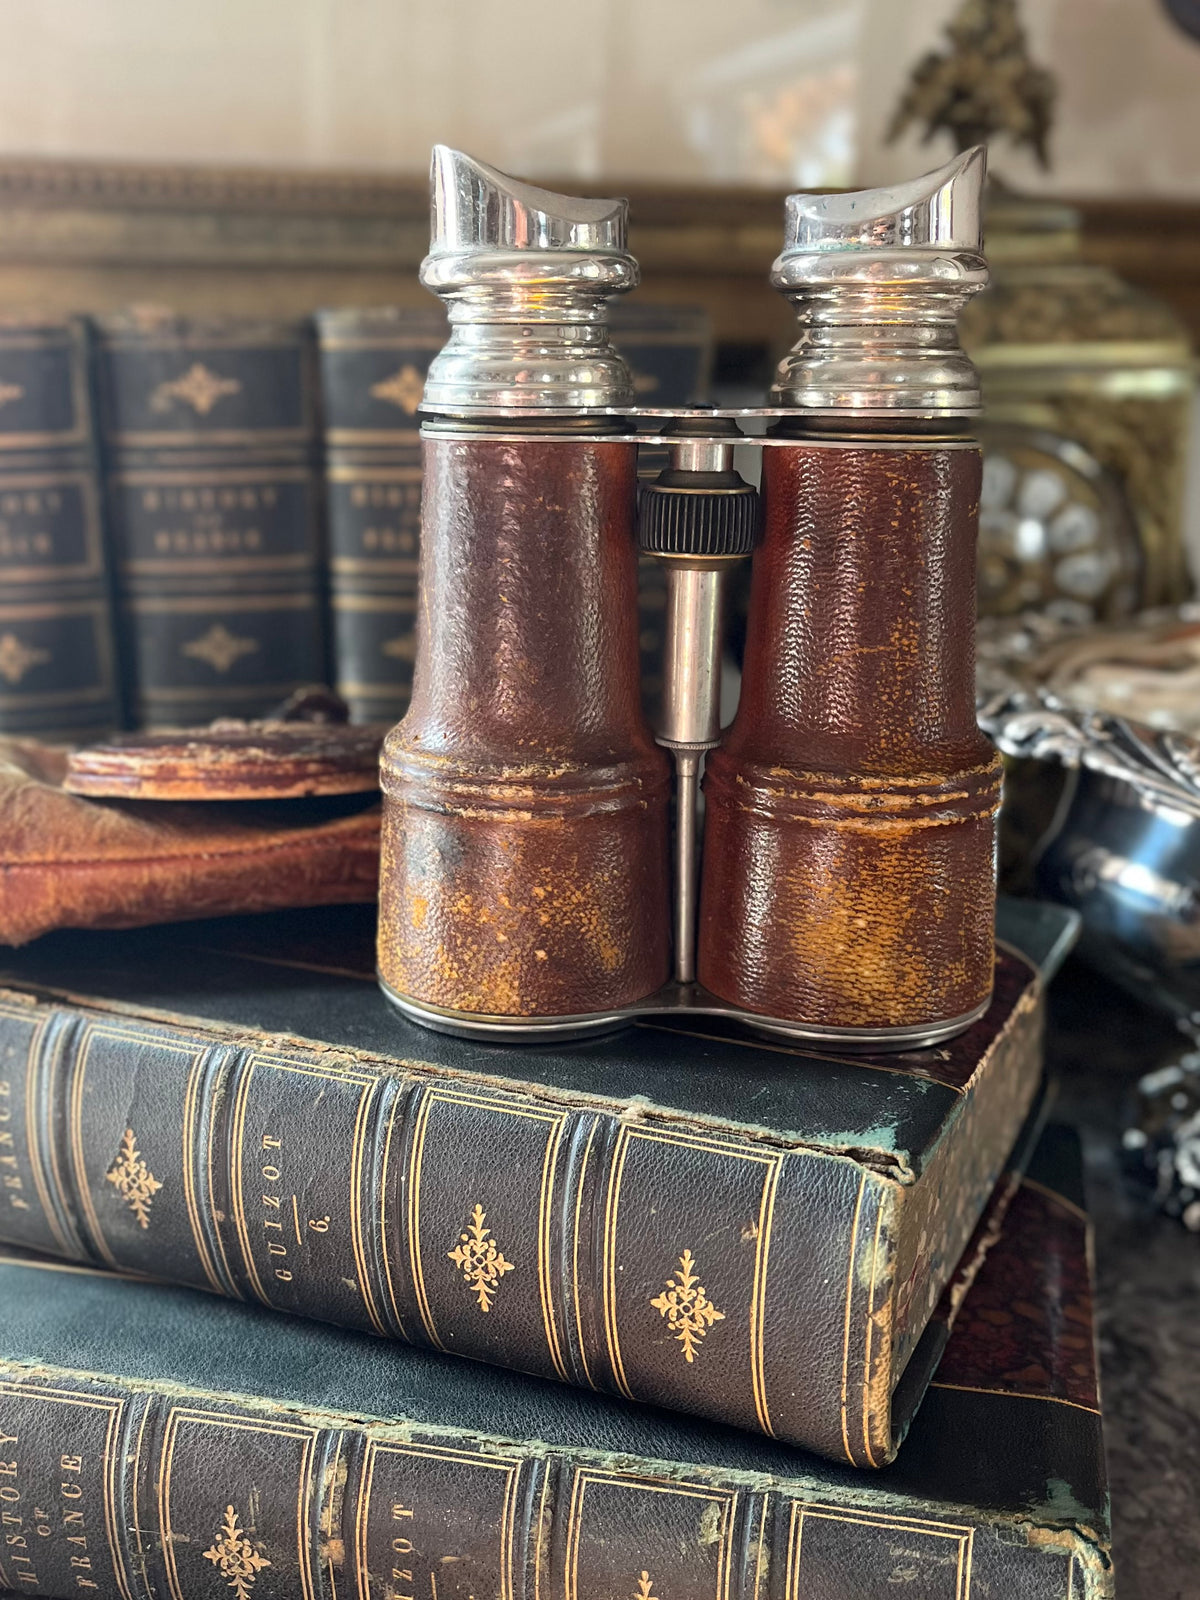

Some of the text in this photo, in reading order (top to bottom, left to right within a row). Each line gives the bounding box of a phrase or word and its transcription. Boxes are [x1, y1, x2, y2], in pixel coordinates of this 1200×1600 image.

[261, 1135, 293, 1281] GUIZOT
[308, 1215, 331, 1233] 6.
[0, 1430, 39, 1585] HISTORY
[34, 1506, 51, 1537] OF
[60, 1454, 99, 1590] FRANCE
